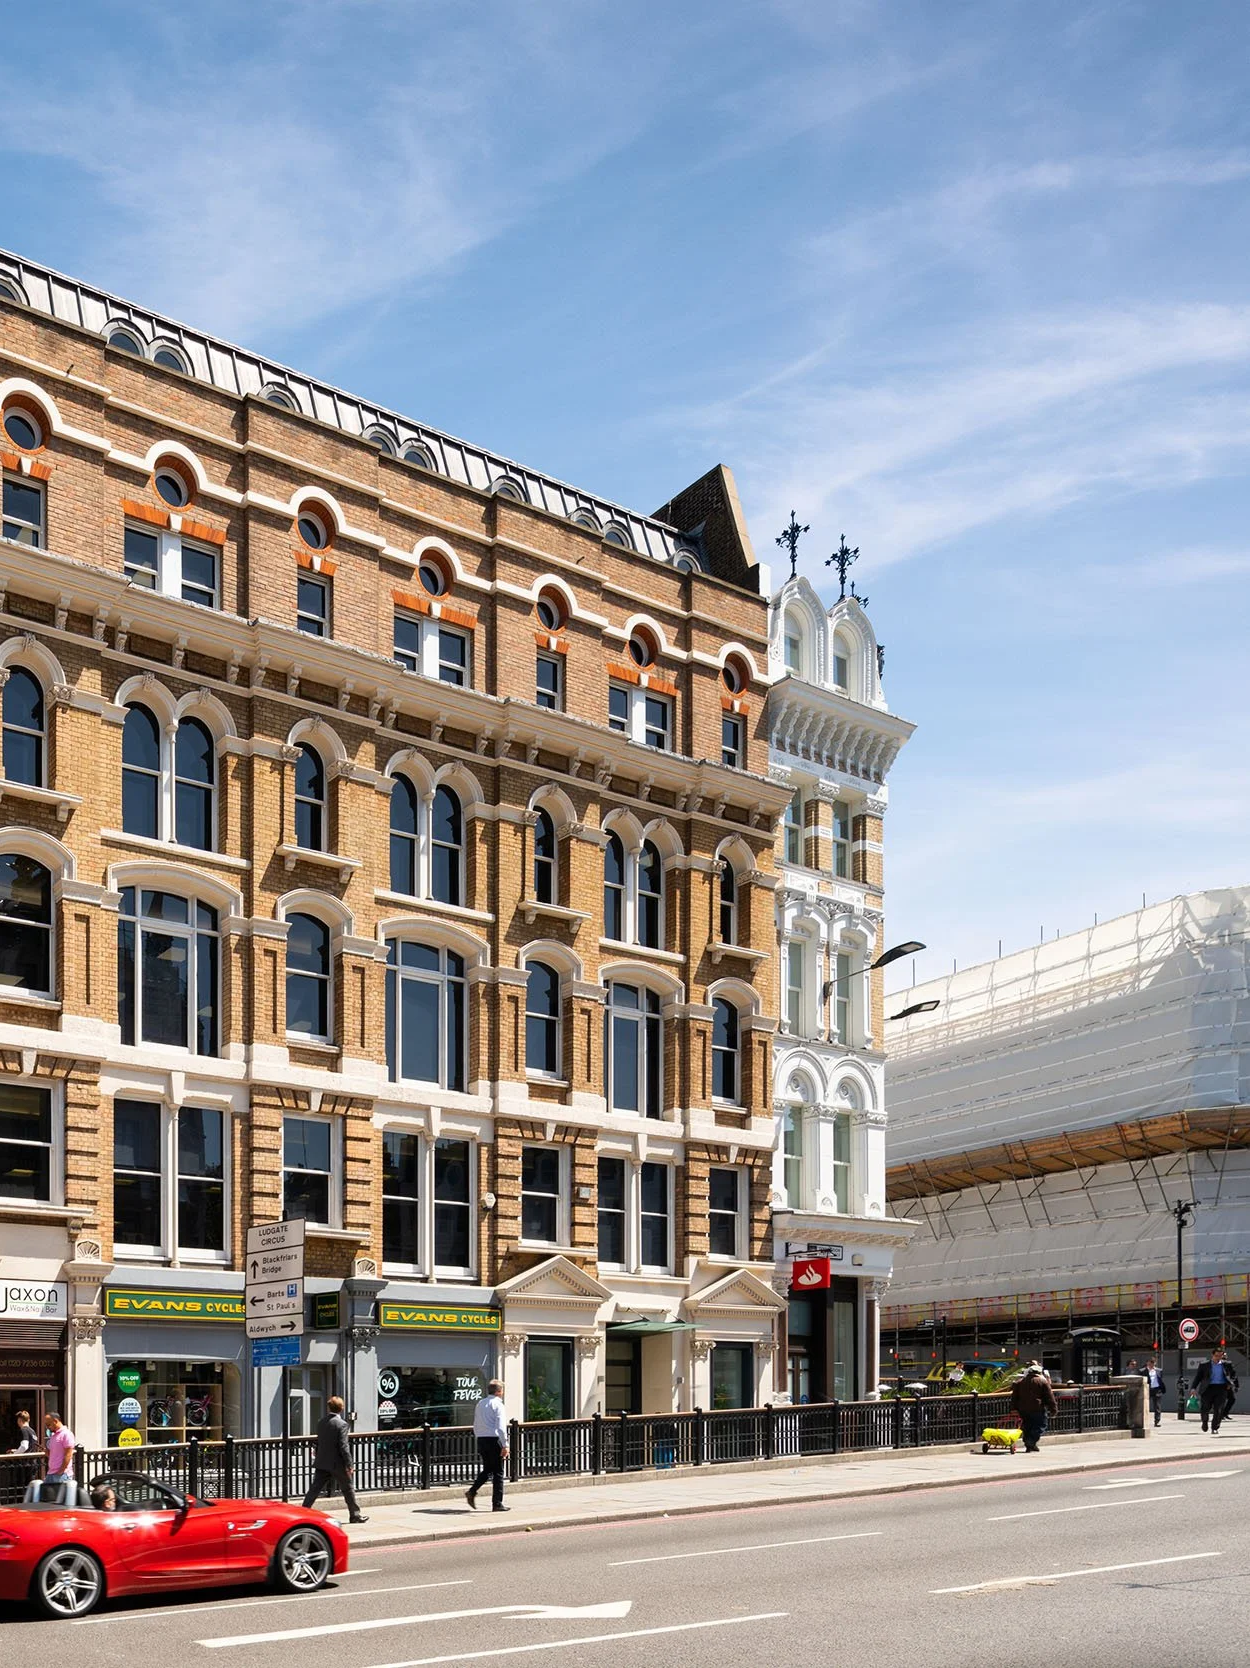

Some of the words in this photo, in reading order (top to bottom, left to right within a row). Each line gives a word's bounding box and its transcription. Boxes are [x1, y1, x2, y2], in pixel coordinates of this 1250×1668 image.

[258, 1224, 289, 1236] LUDGATE
[260, 1235, 286, 1246] CIRCUS
[262, 1253, 298, 1264] Blackfriars
[261, 1266, 282, 1274] Bridge
[267, 1290, 285, 1299] Barts
[45, 1304, 58, 1313] Bar
[113, 1298, 203, 1312] EVANS
[266, 1303, 274, 1311] St
[386, 1311, 459, 1323] EVANS
[461, 1314, 497, 1325] CYCLES
[249, 1324, 277, 1333] Aldwych
[455, 1376, 478, 1388] TOUR
[453, 1389, 483, 1401] FEVER
